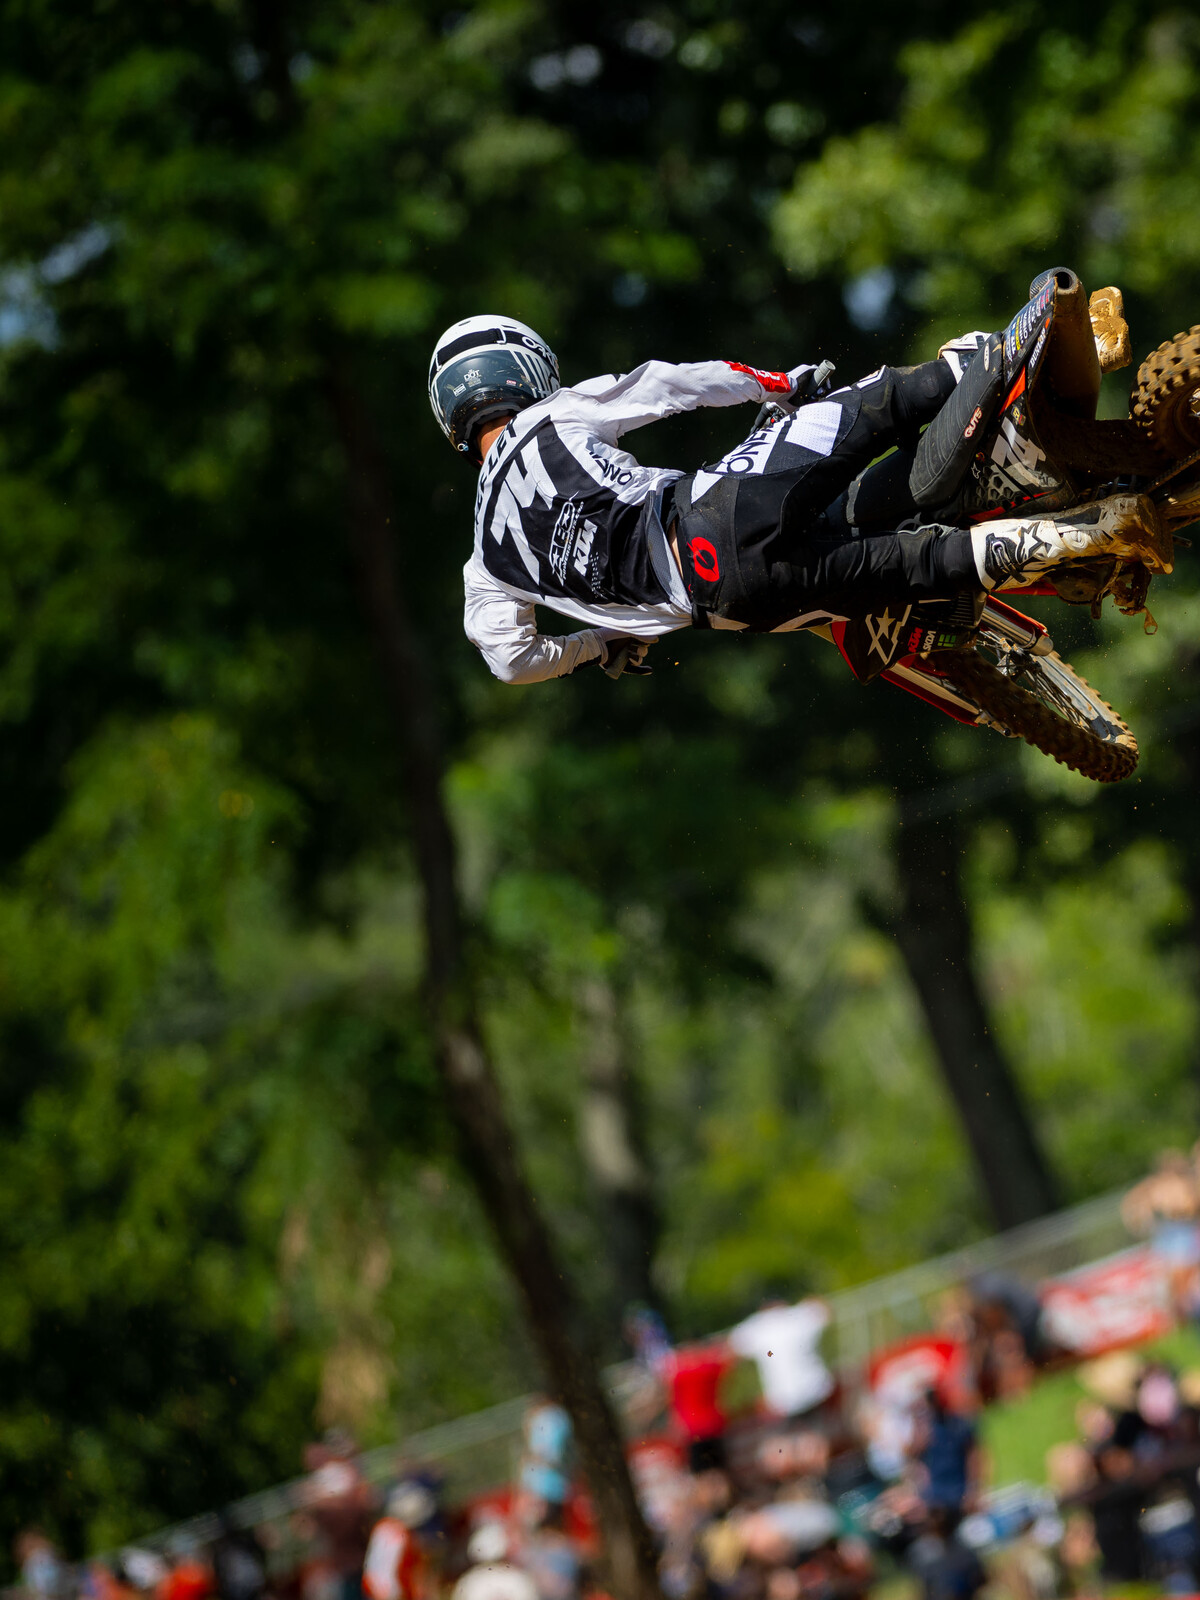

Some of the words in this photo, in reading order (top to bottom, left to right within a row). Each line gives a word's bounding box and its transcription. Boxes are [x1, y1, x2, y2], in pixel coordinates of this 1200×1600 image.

[1030, 327, 1046, 367] DUNLOP
[463, 370, 480, 382] DOT
[964, 407, 983, 438] GUTS
[476, 415, 519, 526] EFLEY
[990, 417, 1046, 486] 74
[489, 435, 559, 587] 74
[572, 519, 598, 577] KTM
[907, 627, 923, 653] KTM
